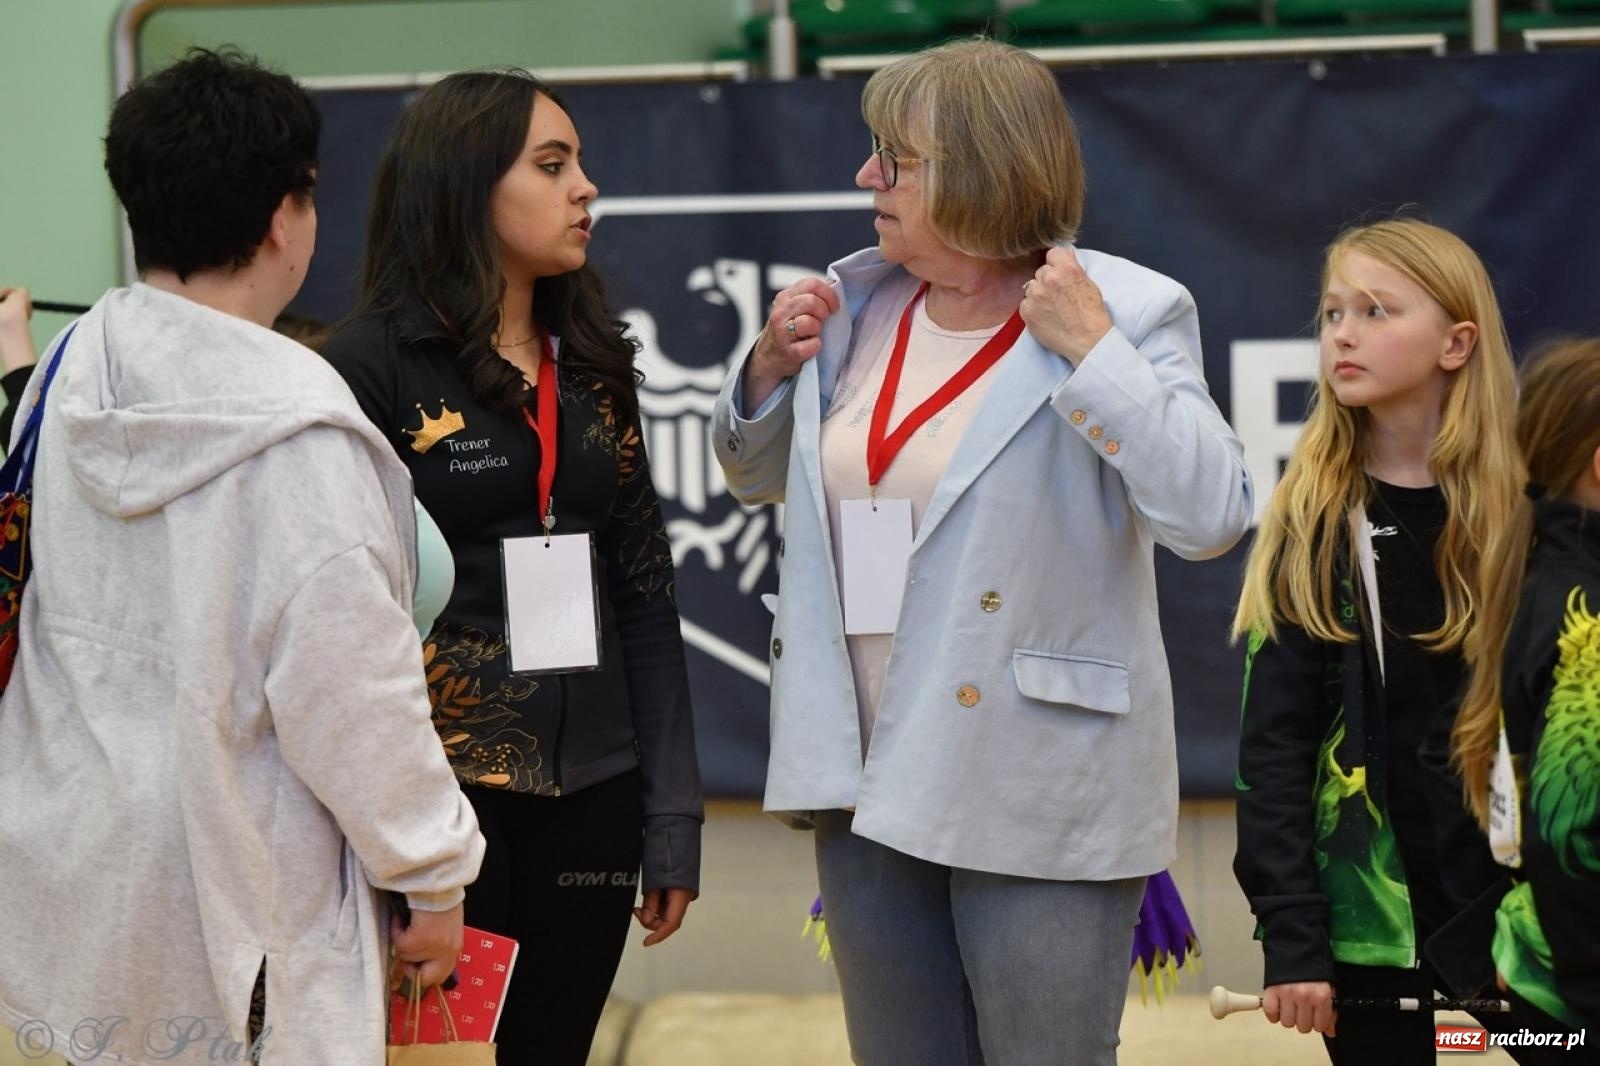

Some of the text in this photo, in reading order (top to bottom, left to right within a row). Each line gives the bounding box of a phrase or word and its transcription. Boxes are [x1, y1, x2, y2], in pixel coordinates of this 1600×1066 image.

[444, 438, 491, 453] Trener
[449, 454, 510, 475] Angelica
[558, 871, 608, 886] GYM
